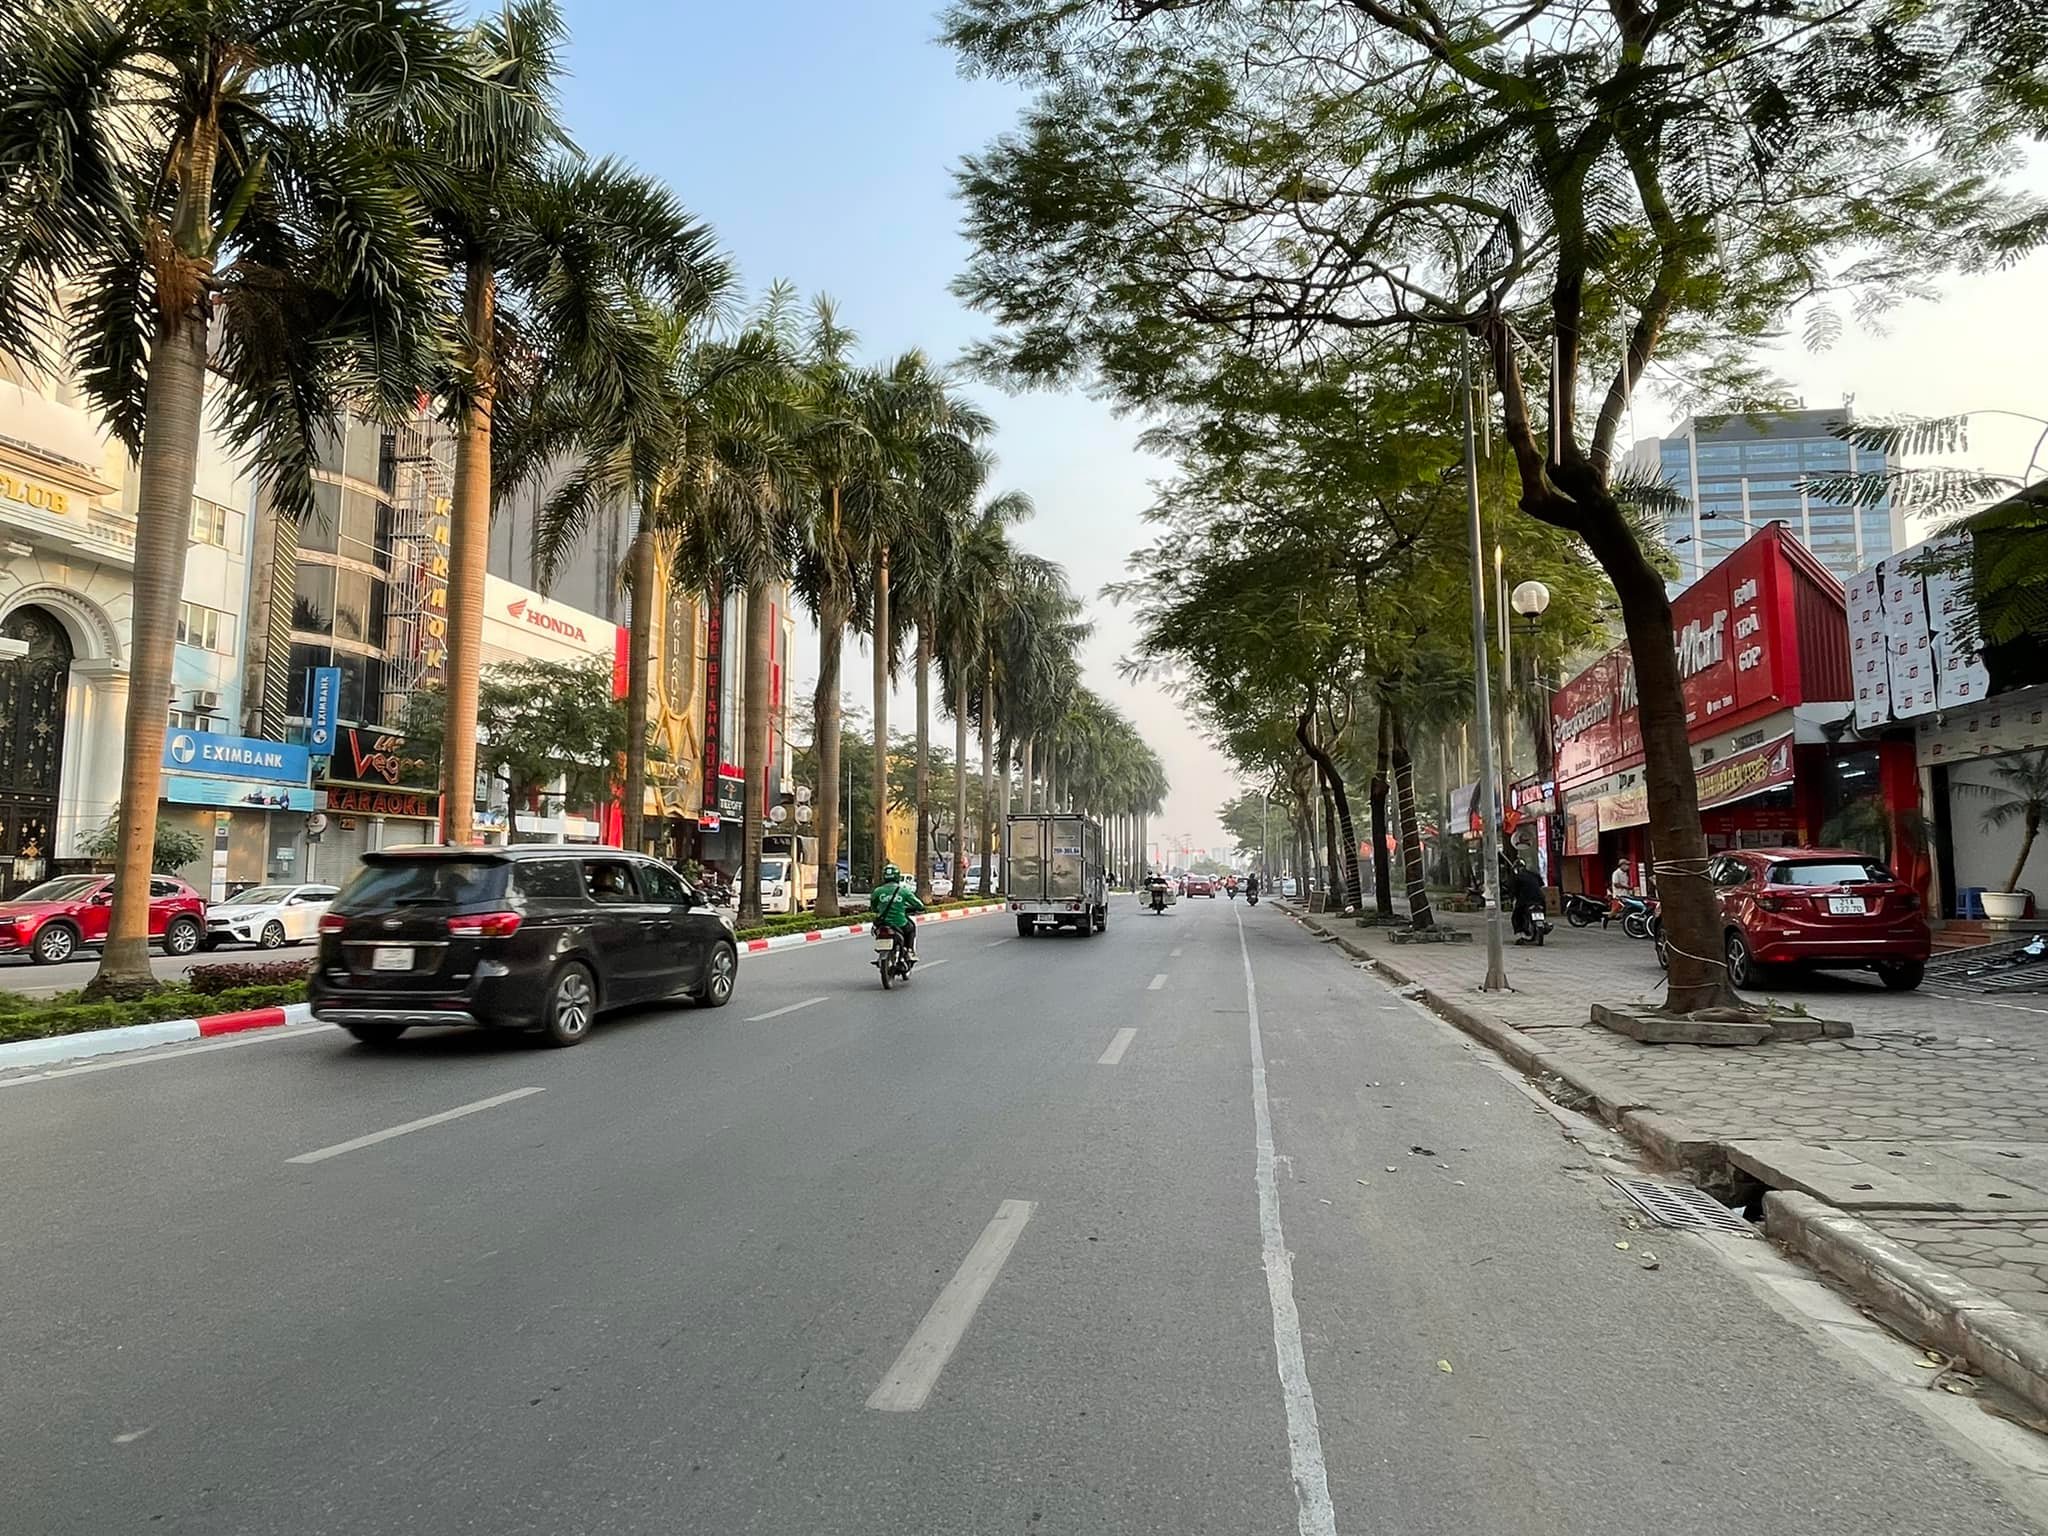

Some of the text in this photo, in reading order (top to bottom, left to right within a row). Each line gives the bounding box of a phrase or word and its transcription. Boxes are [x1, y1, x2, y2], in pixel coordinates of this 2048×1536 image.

[526, 608, 587, 643] HONDA
[316, 676, 329, 726] EXIMBANK
[202, 744, 284, 769] EXIMBANK
[327, 786, 428, 816] KARAOKE
[879, 893, 904, 904] Grb
